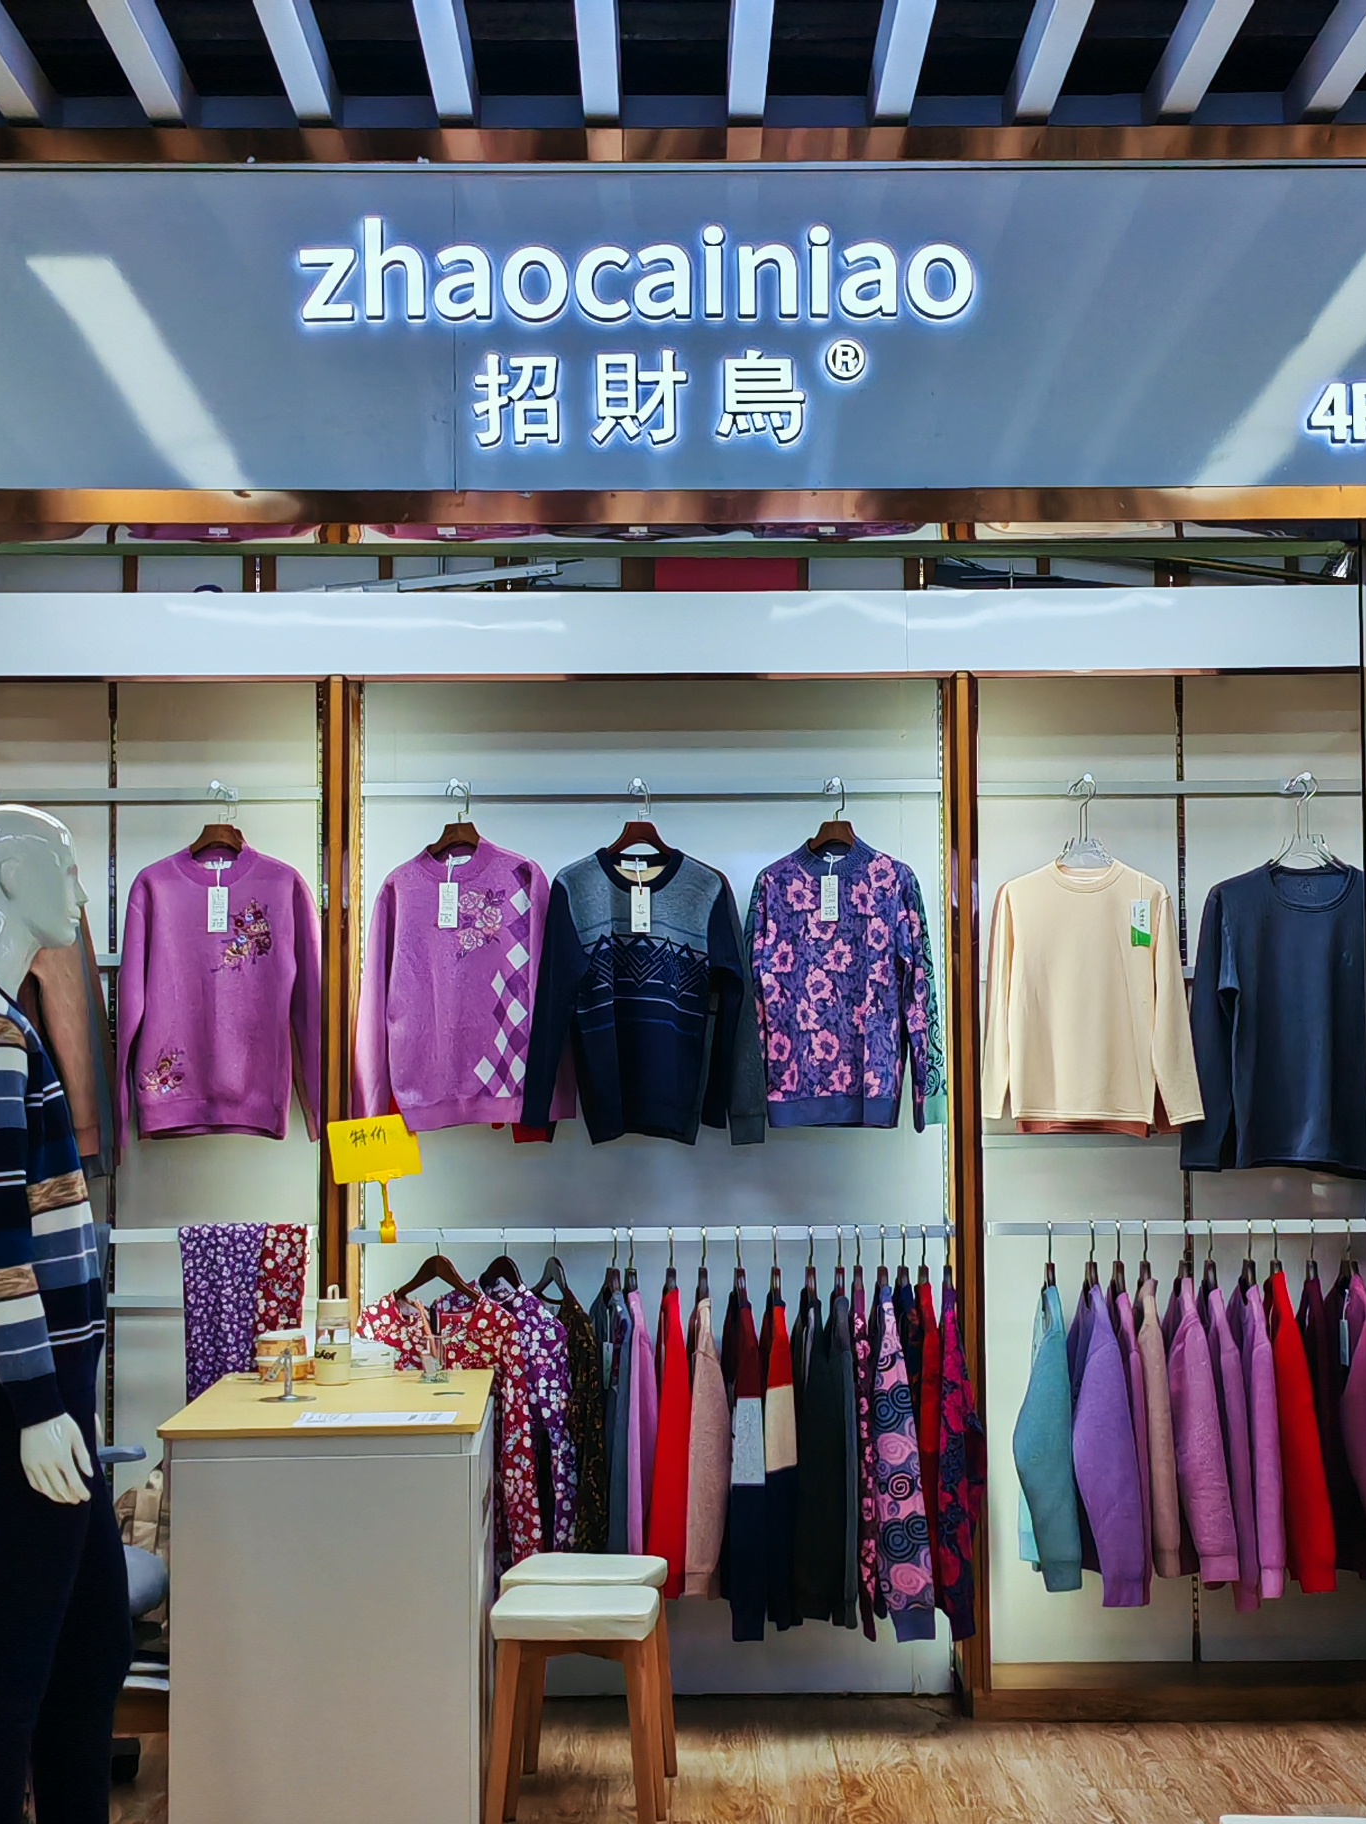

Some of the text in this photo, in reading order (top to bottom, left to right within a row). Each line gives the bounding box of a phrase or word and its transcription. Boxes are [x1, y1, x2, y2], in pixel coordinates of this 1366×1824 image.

[298, 215, 976, 323] zhaocainiao
[475, 350, 806, 447] 招財鳥
